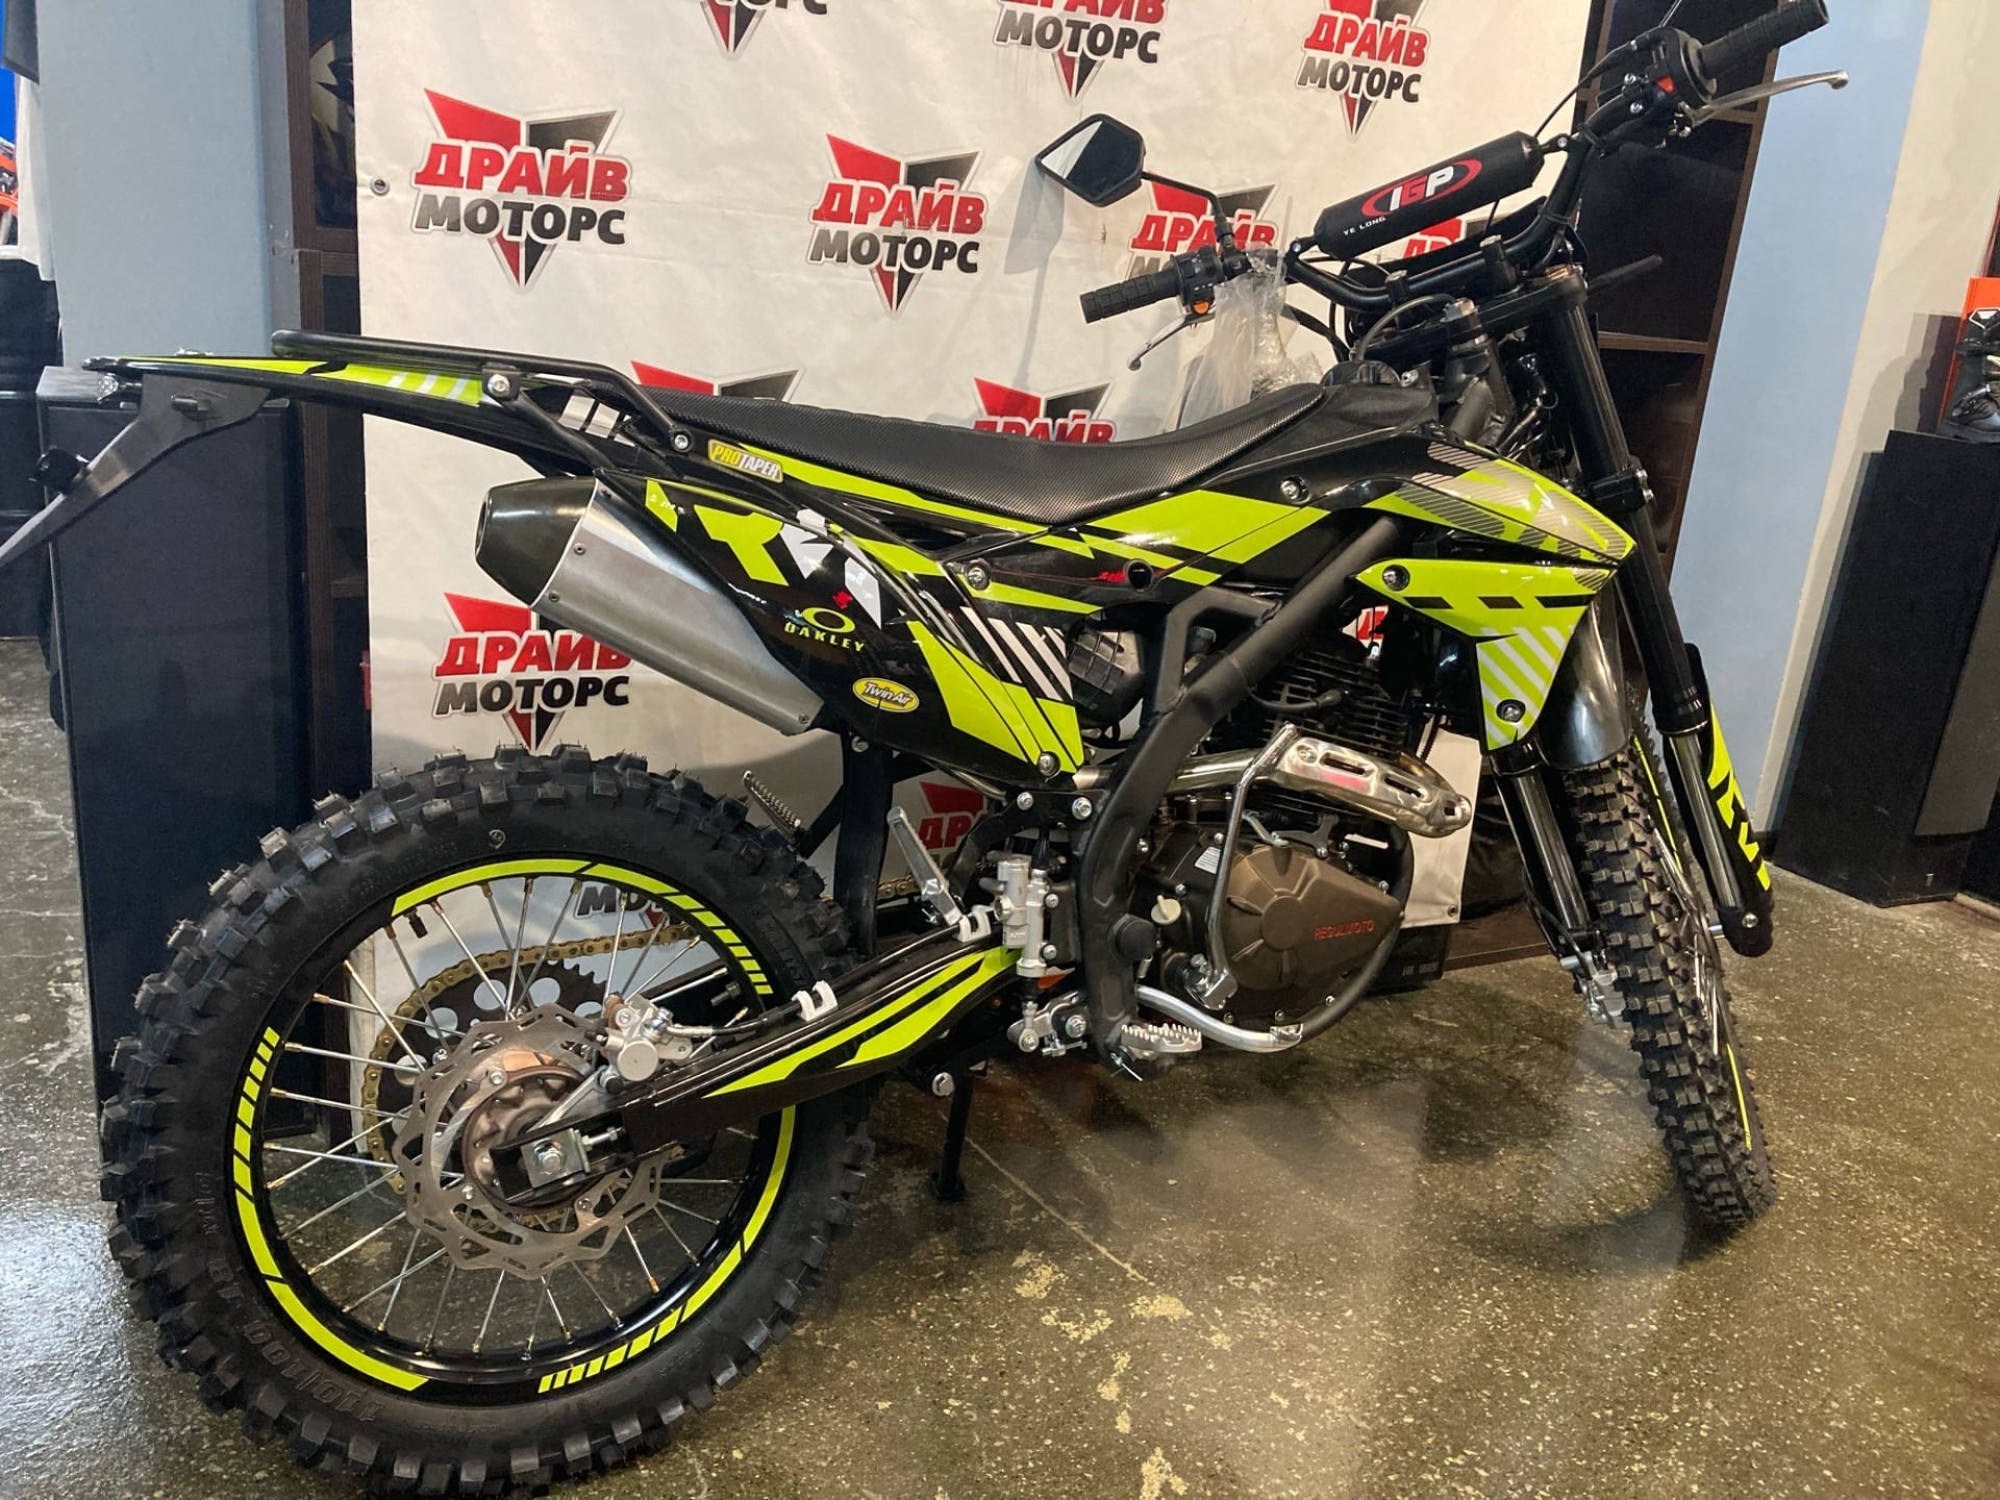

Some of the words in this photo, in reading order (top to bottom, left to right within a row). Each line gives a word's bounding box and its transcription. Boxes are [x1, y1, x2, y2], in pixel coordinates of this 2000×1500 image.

[996, 10, 1161, 64] МОТОРС
[1304, 14, 1427, 67] ДРАЙВ
[1297, 56, 1422, 103] МОТОРС
[414, 143, 628, 202] ДРАЙВ
[1390, 166, 1453, 211] IGP
[415, 194, 625, 245] МОТОРС
[812, 183, 984, 234] ДРАЙВ
[1343, 227, 1356, 236] YE
[1359, 216, 1386, 230] LONG
[809, 229, 980, 274] МОТОРС
[784, 621, 866, 652] OAKLEY
[435, 675, 630, 716] МОТОРС
